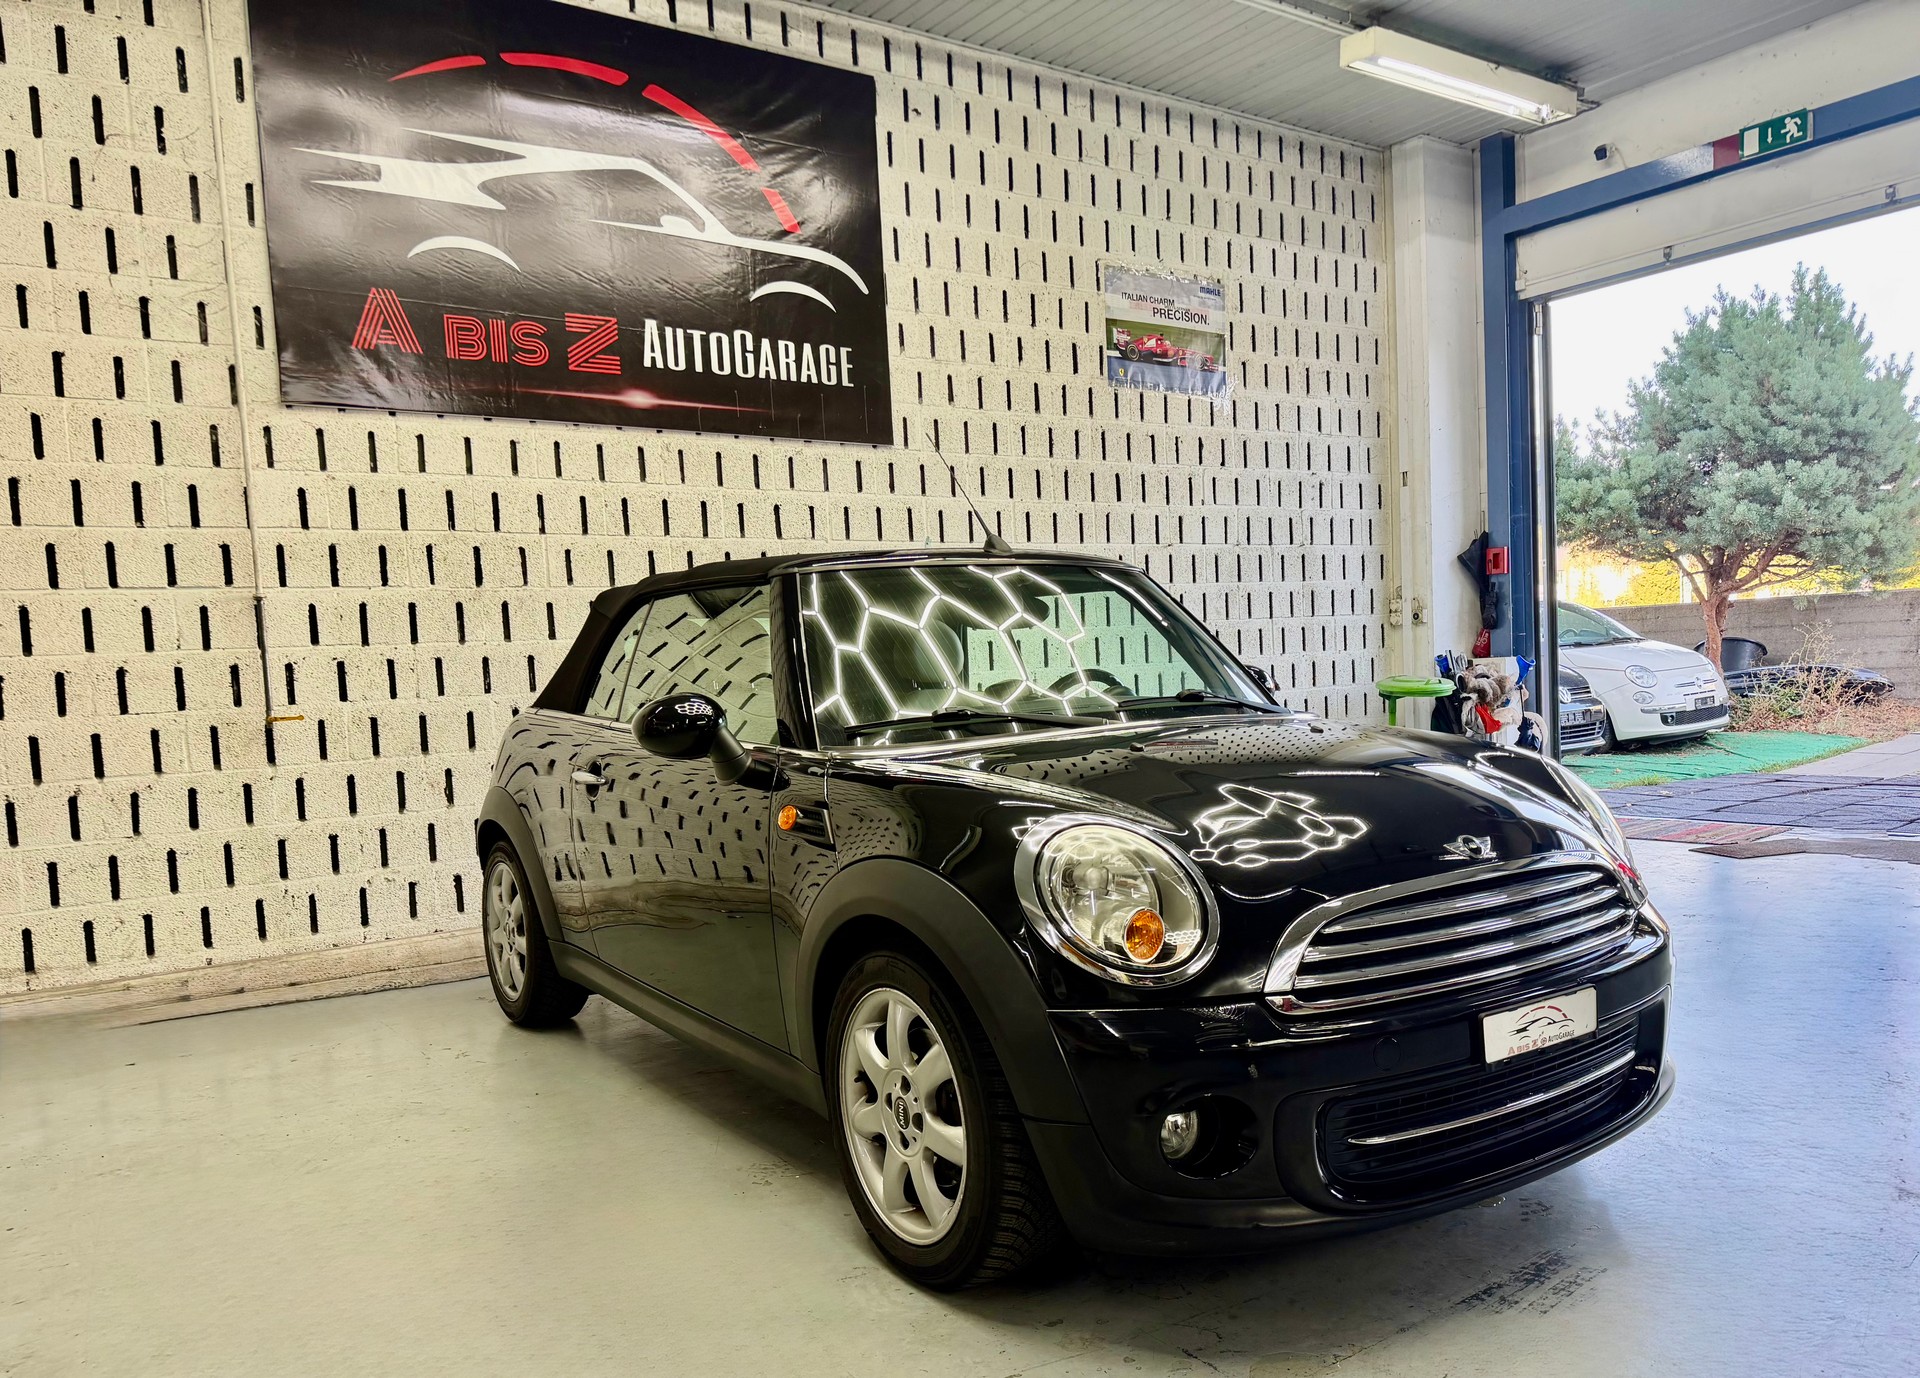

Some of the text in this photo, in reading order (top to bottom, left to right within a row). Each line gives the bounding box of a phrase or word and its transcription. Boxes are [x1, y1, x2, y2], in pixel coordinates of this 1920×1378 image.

[1121, 292, 1175, 306] ITALIAN CHARM
[1199, 286, 1221, 296] MAHLE
[1152, 307, 1210, 326] PRECISION.
[352, 287, 423, 354] A
[443, 313, 550, 366] BIS
[564, 312, 621, 375] Z
[1508, 1046, 1515, 1055] A
[898, 1101, 906, 1128] MINI
